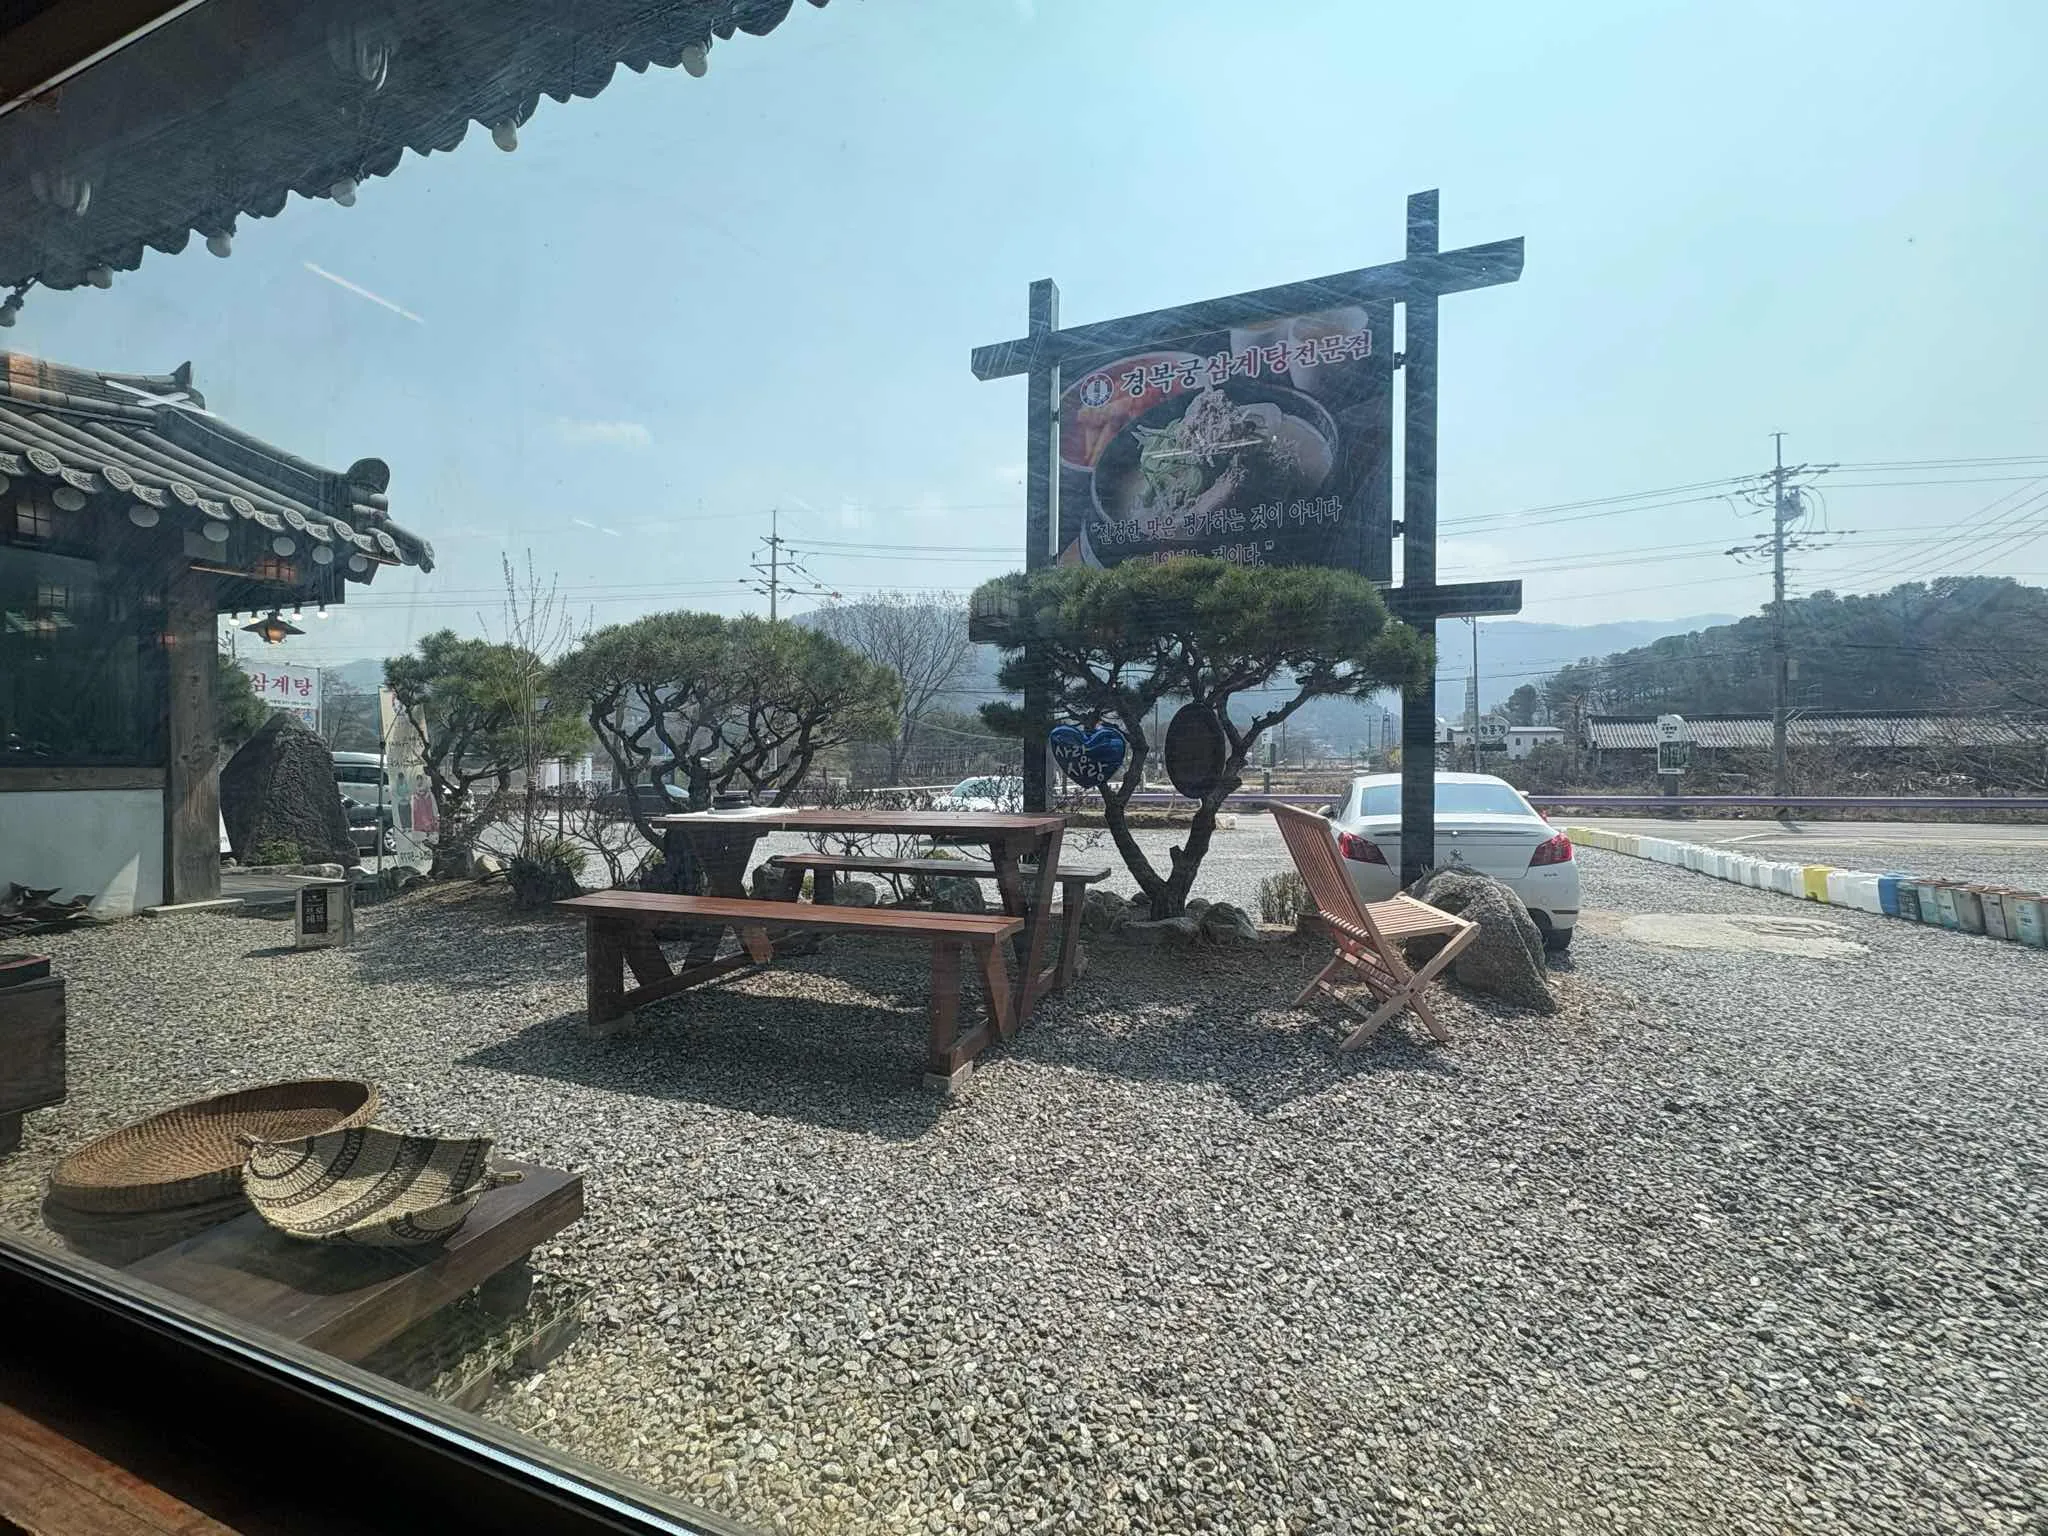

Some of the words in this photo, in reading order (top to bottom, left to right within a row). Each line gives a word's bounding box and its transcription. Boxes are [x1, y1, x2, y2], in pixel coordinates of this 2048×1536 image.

[1146, 516, 1176, 540] 맛은
[1183, 508, 1245, 537] 평가하는
[1250, 502, 1283, 529] 것이
[1289, 496, 1342, 525] 아니다
[249, 672, 312, 697] 삼계탕
[1055, 744, 1088, 763] 사랑
[1067, 761, 1108, 781] 사랑
